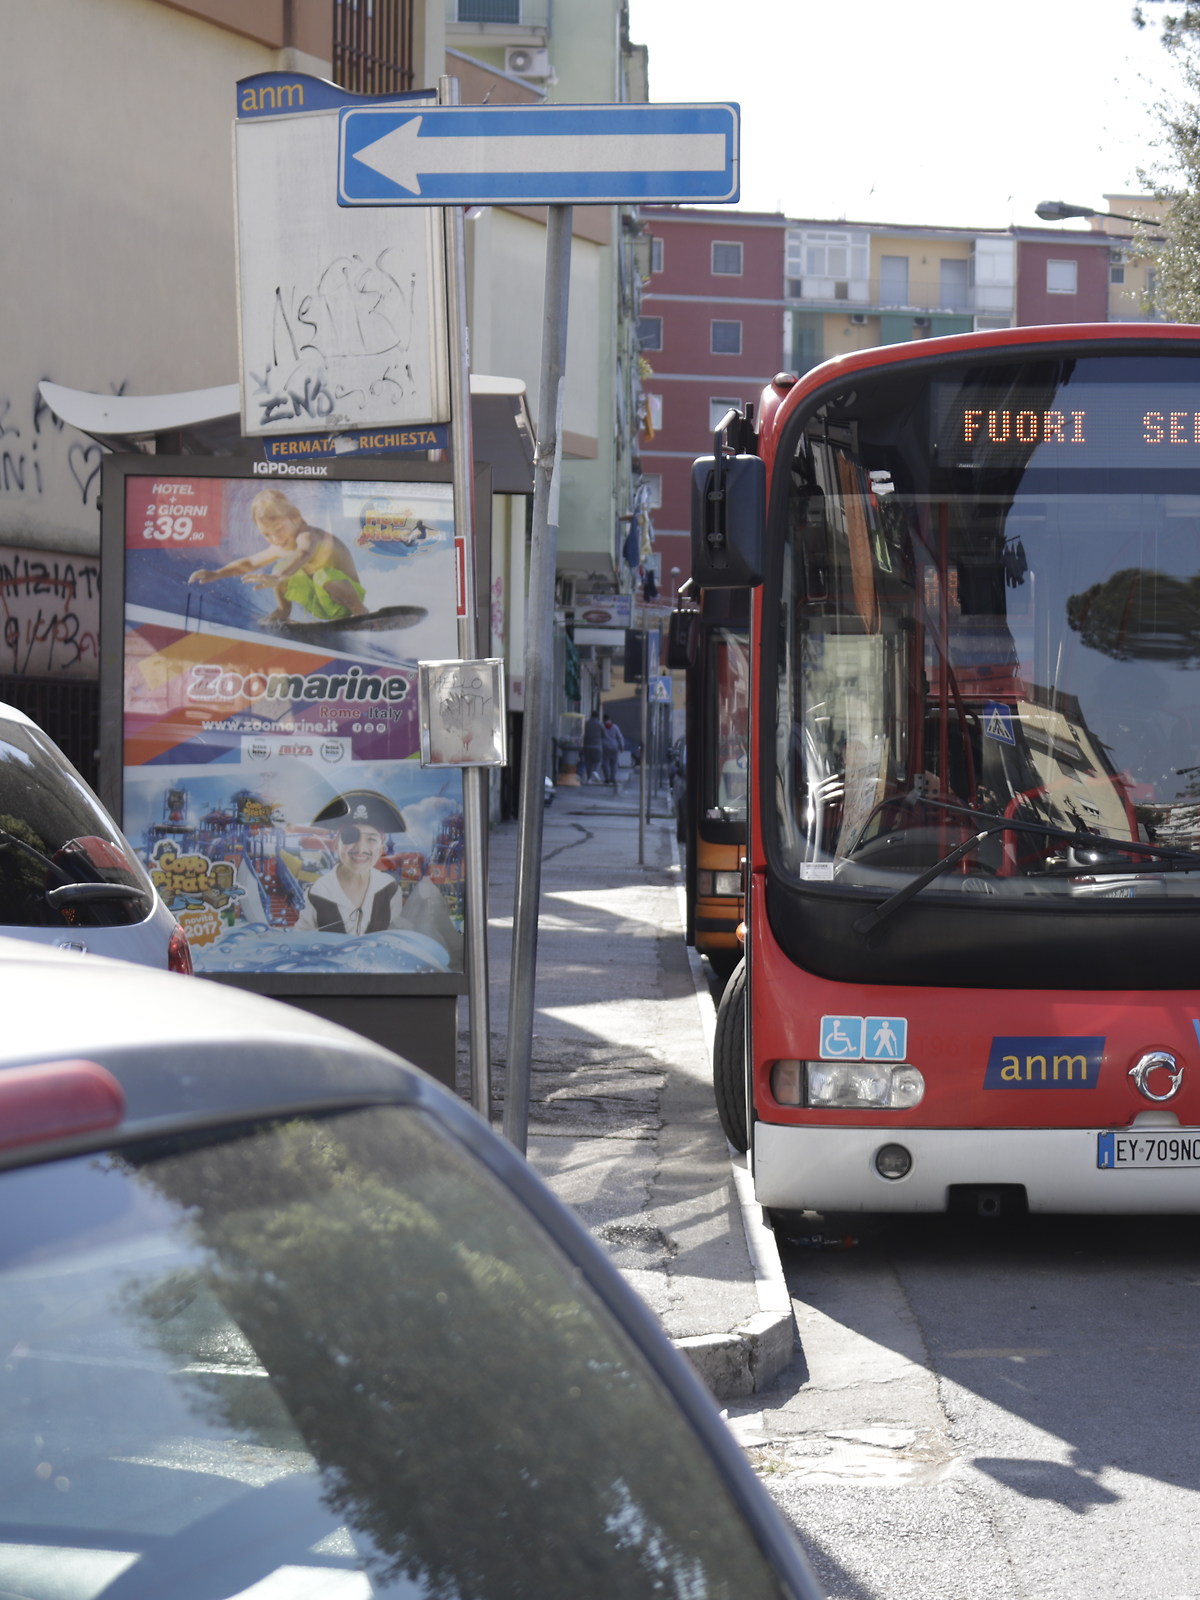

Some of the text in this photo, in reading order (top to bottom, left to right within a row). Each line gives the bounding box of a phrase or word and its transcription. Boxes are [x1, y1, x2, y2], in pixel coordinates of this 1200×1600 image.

[242, 83, 304, 111] anm
[963, 410, 1086, 443] FUORI
[271, 438, 336, 455] FERMATA
[359, 431, 437, 449] RICHIESTA
[253, 462, 327, 475] IGPDecaux
[152, 484, 195, 495] HOTEL
[146, 504, 208, 517] 2 GIORNI
[187, 666, 409, 702] Zoomarine
[320, 707, 401, 721] Rome Italy
[202, 719, 338, 733] www.zoomarine.it
[184, 920, 218, 938] 2017
[1001, 1053, 1087, 1081] anm
